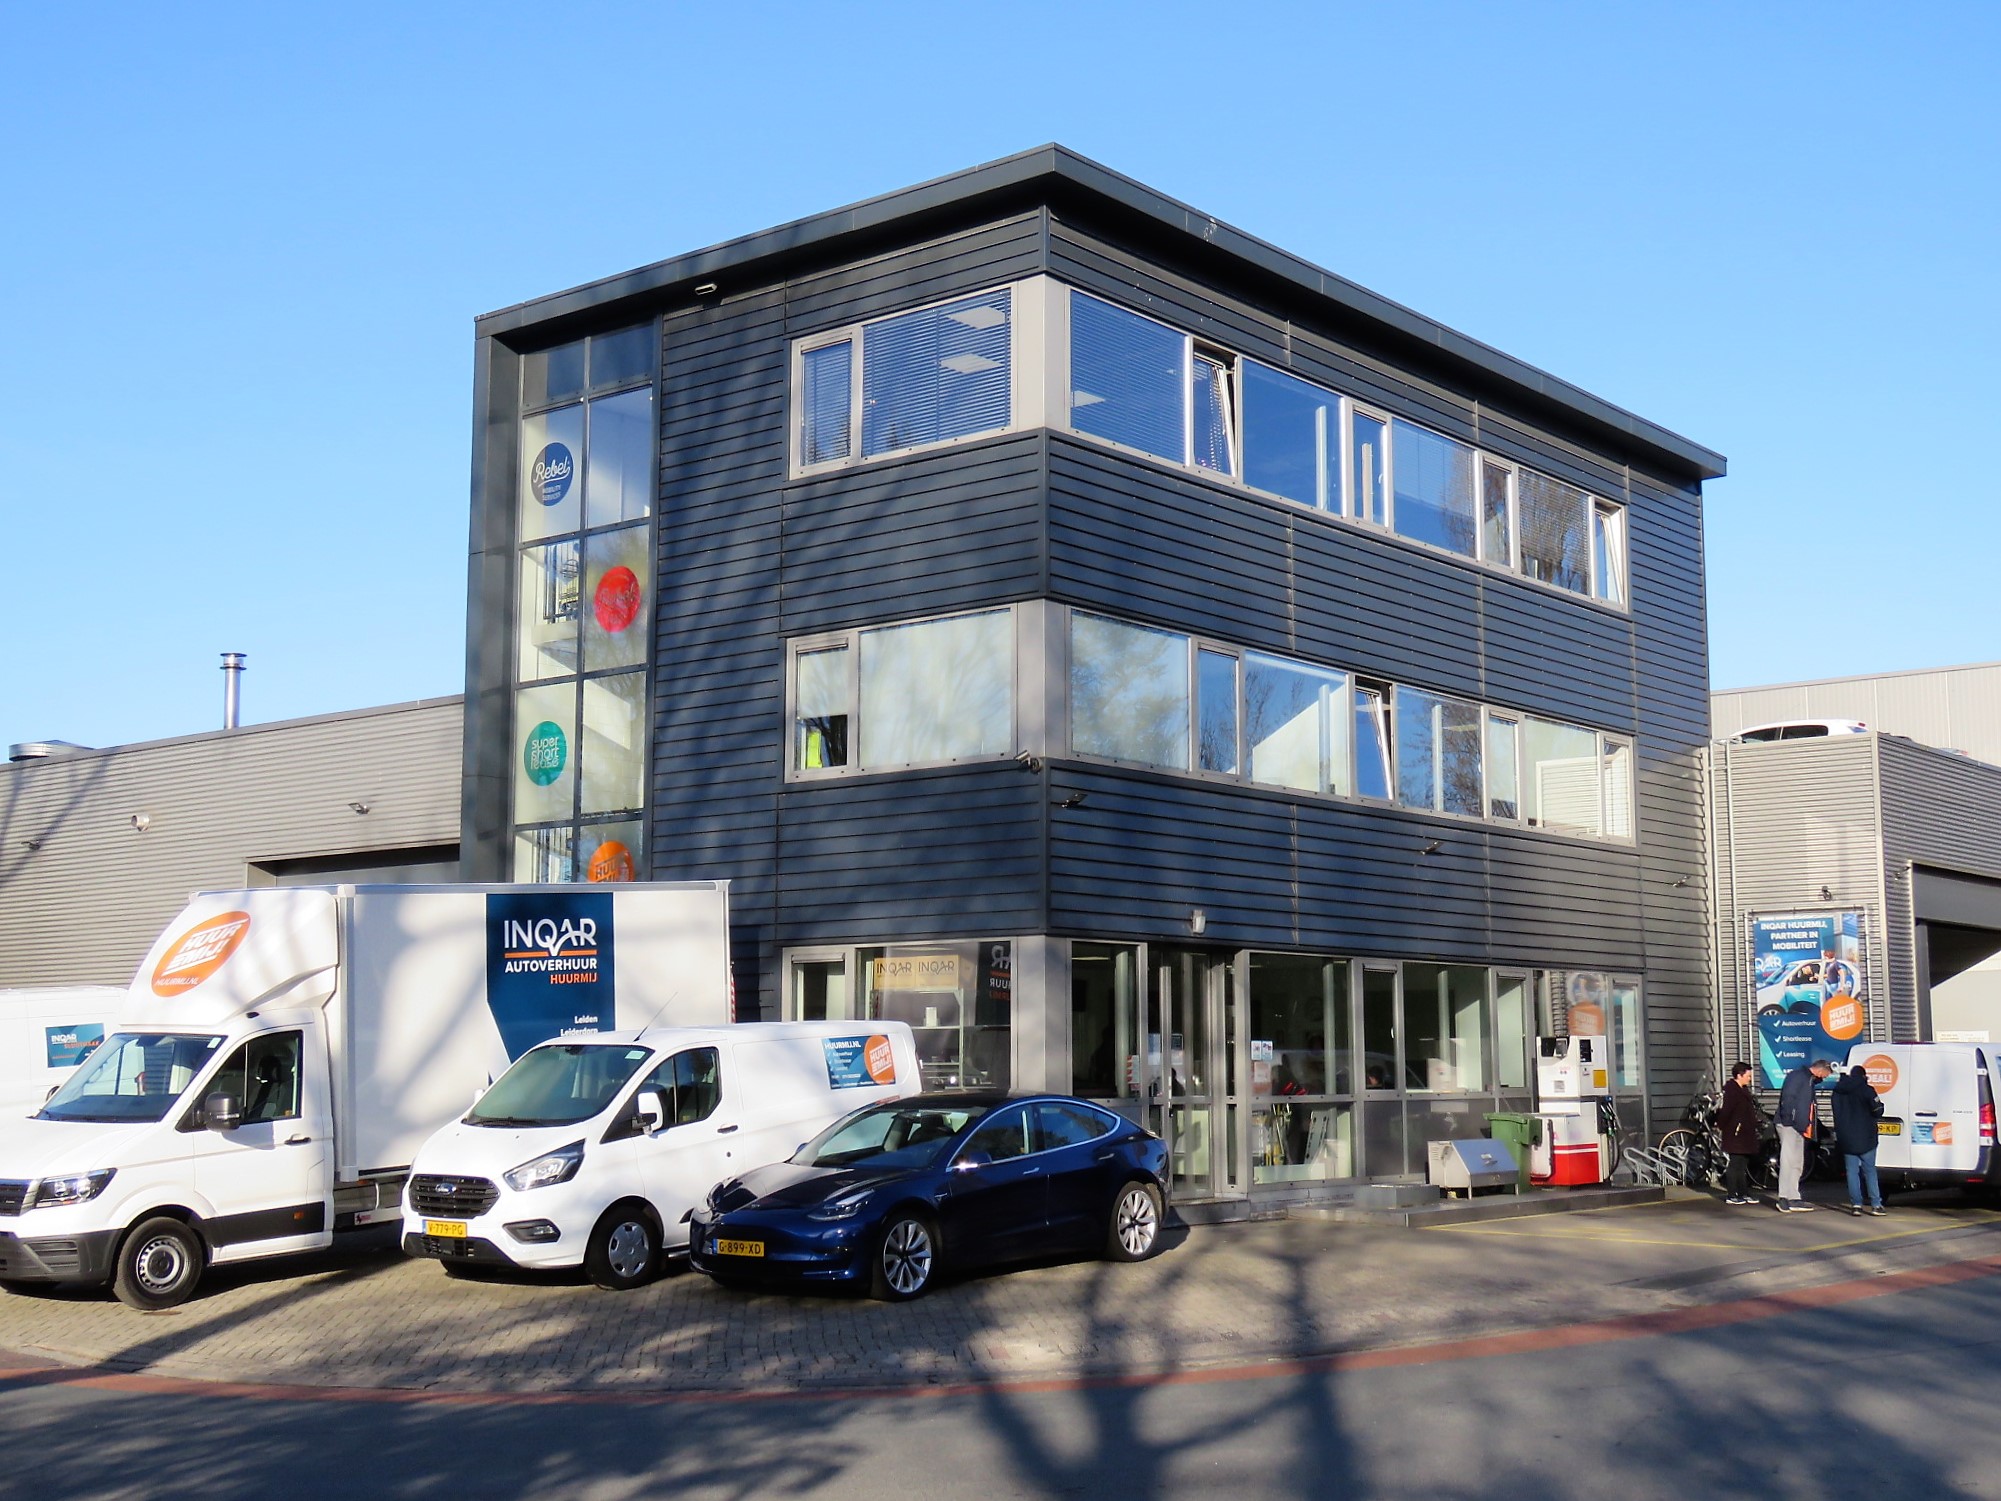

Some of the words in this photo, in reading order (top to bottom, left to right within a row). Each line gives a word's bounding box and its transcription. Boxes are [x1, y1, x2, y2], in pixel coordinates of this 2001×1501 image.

[533, 456, 571, 483] Rebel
[532, 737, 559, 750] super
[532, 747, 559, 760] short
[1761, 922, 1787, 931] INQAR
[179, 923, 243, 955] HUUR
[504, 918, 597, 957] INQAR
[1770, 932, 1808, 940] PARTNER
[1809, 931, 1818, 939] IN
[1772, 941, 1818, 950] MOBILITEIT
[505, 958, 598, 973] AUTOVERHUUR
[876, 962, 912, 976] INQAR
[918, 961, 955, 975] INQAR
[550, 973, 597, 985] HUURMIJ
[574, 1015, 598, 1024] Leiden
[560, 1027, 598, 1037] Leiderdorp
[1782, 1035, 1812, 1043] Shortlease
[870, 1045, 891, 1063] HUUR
[428, 1222, 463, 1235] V-779-PG
[719, 1241, 761, 1254] G-899-XD
